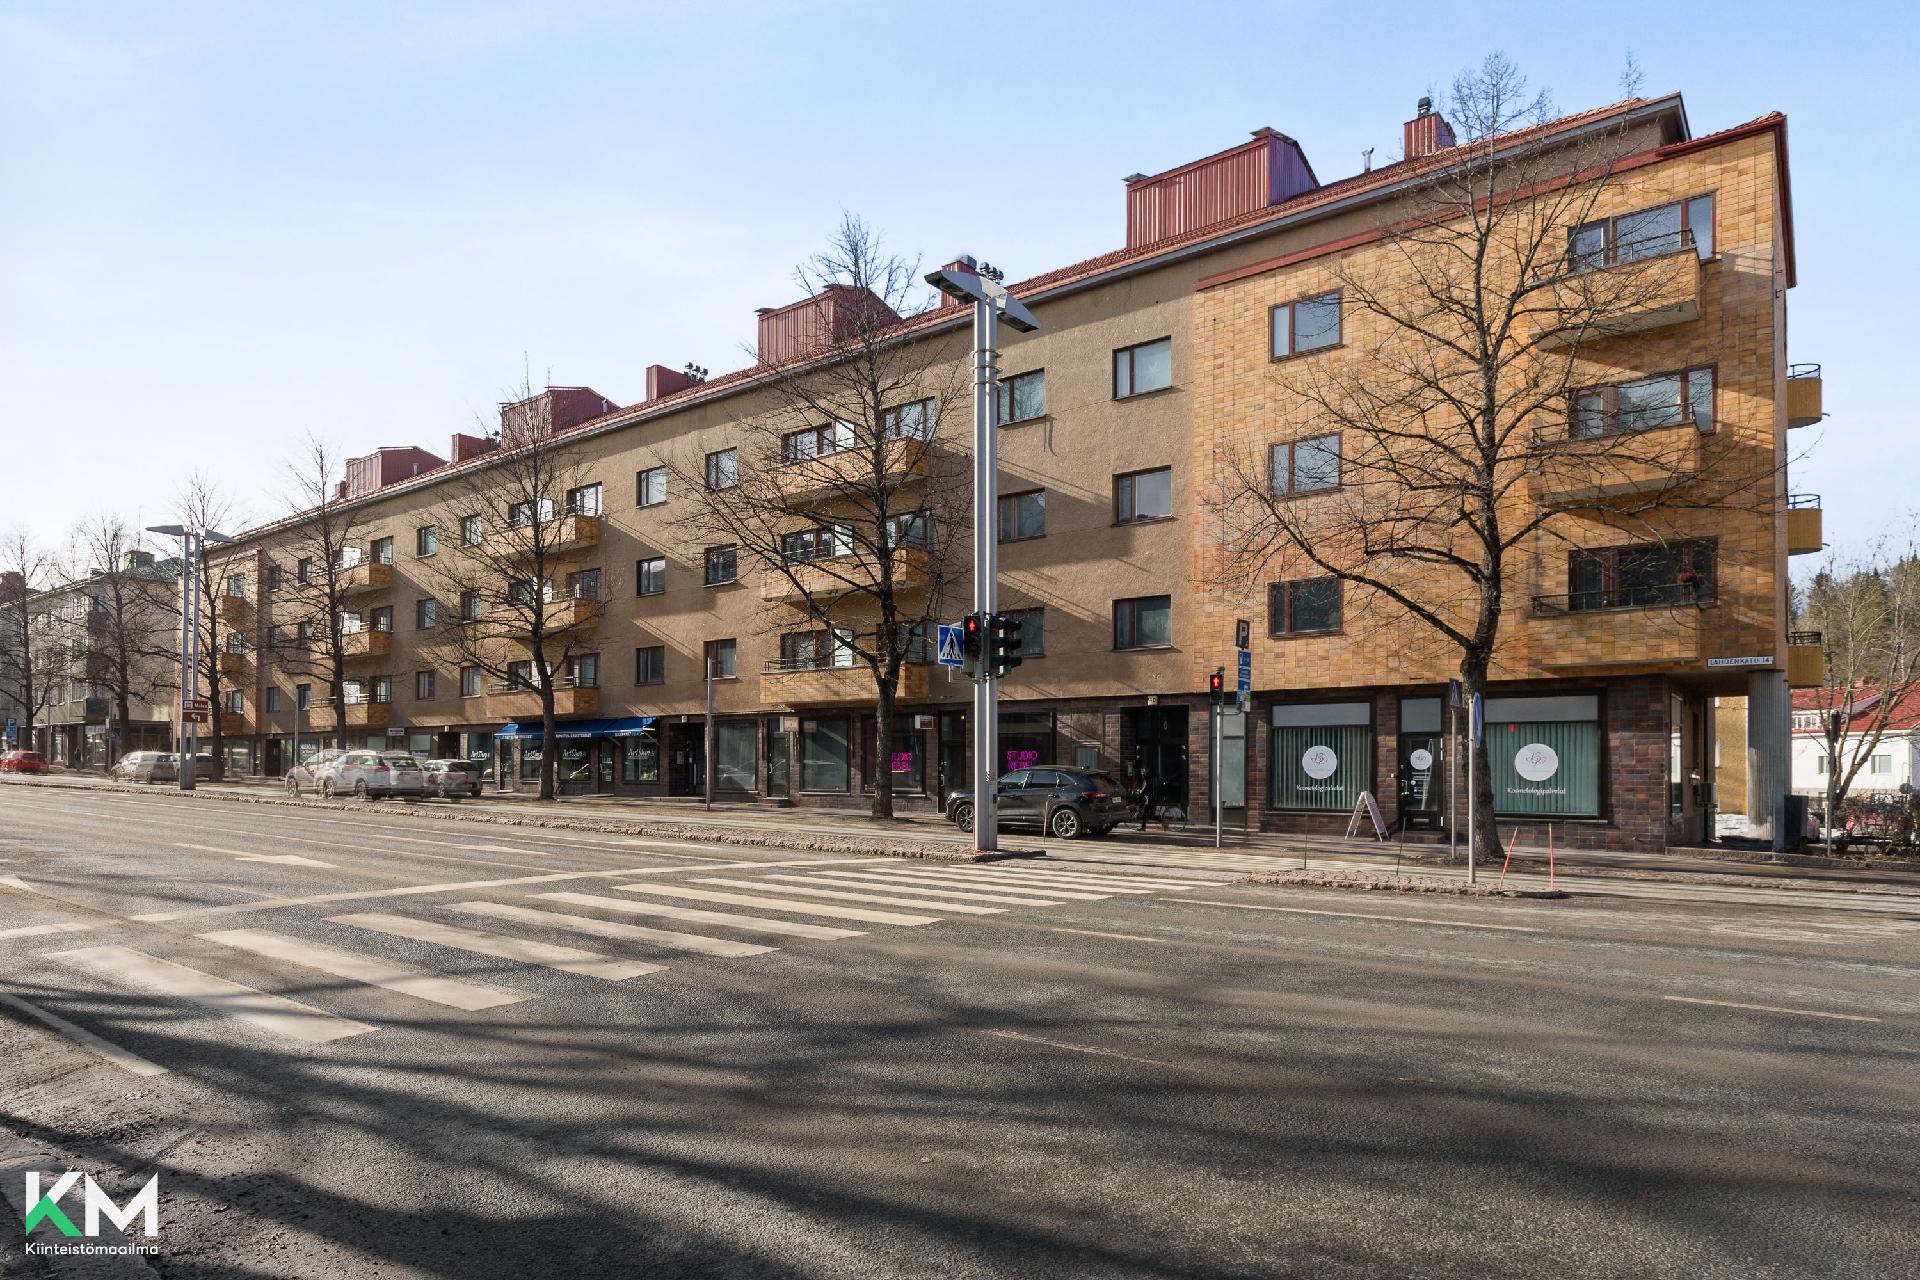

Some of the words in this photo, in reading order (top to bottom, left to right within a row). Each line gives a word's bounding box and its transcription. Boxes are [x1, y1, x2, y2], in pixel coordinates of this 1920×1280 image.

[1710, 658, 1759, 666] LAHDENKATU
[892, 752, 912, 760] TUDIO
[1007, 751, 1038, 761] STUDIO
[892, 761, 911, 770] EBEL
